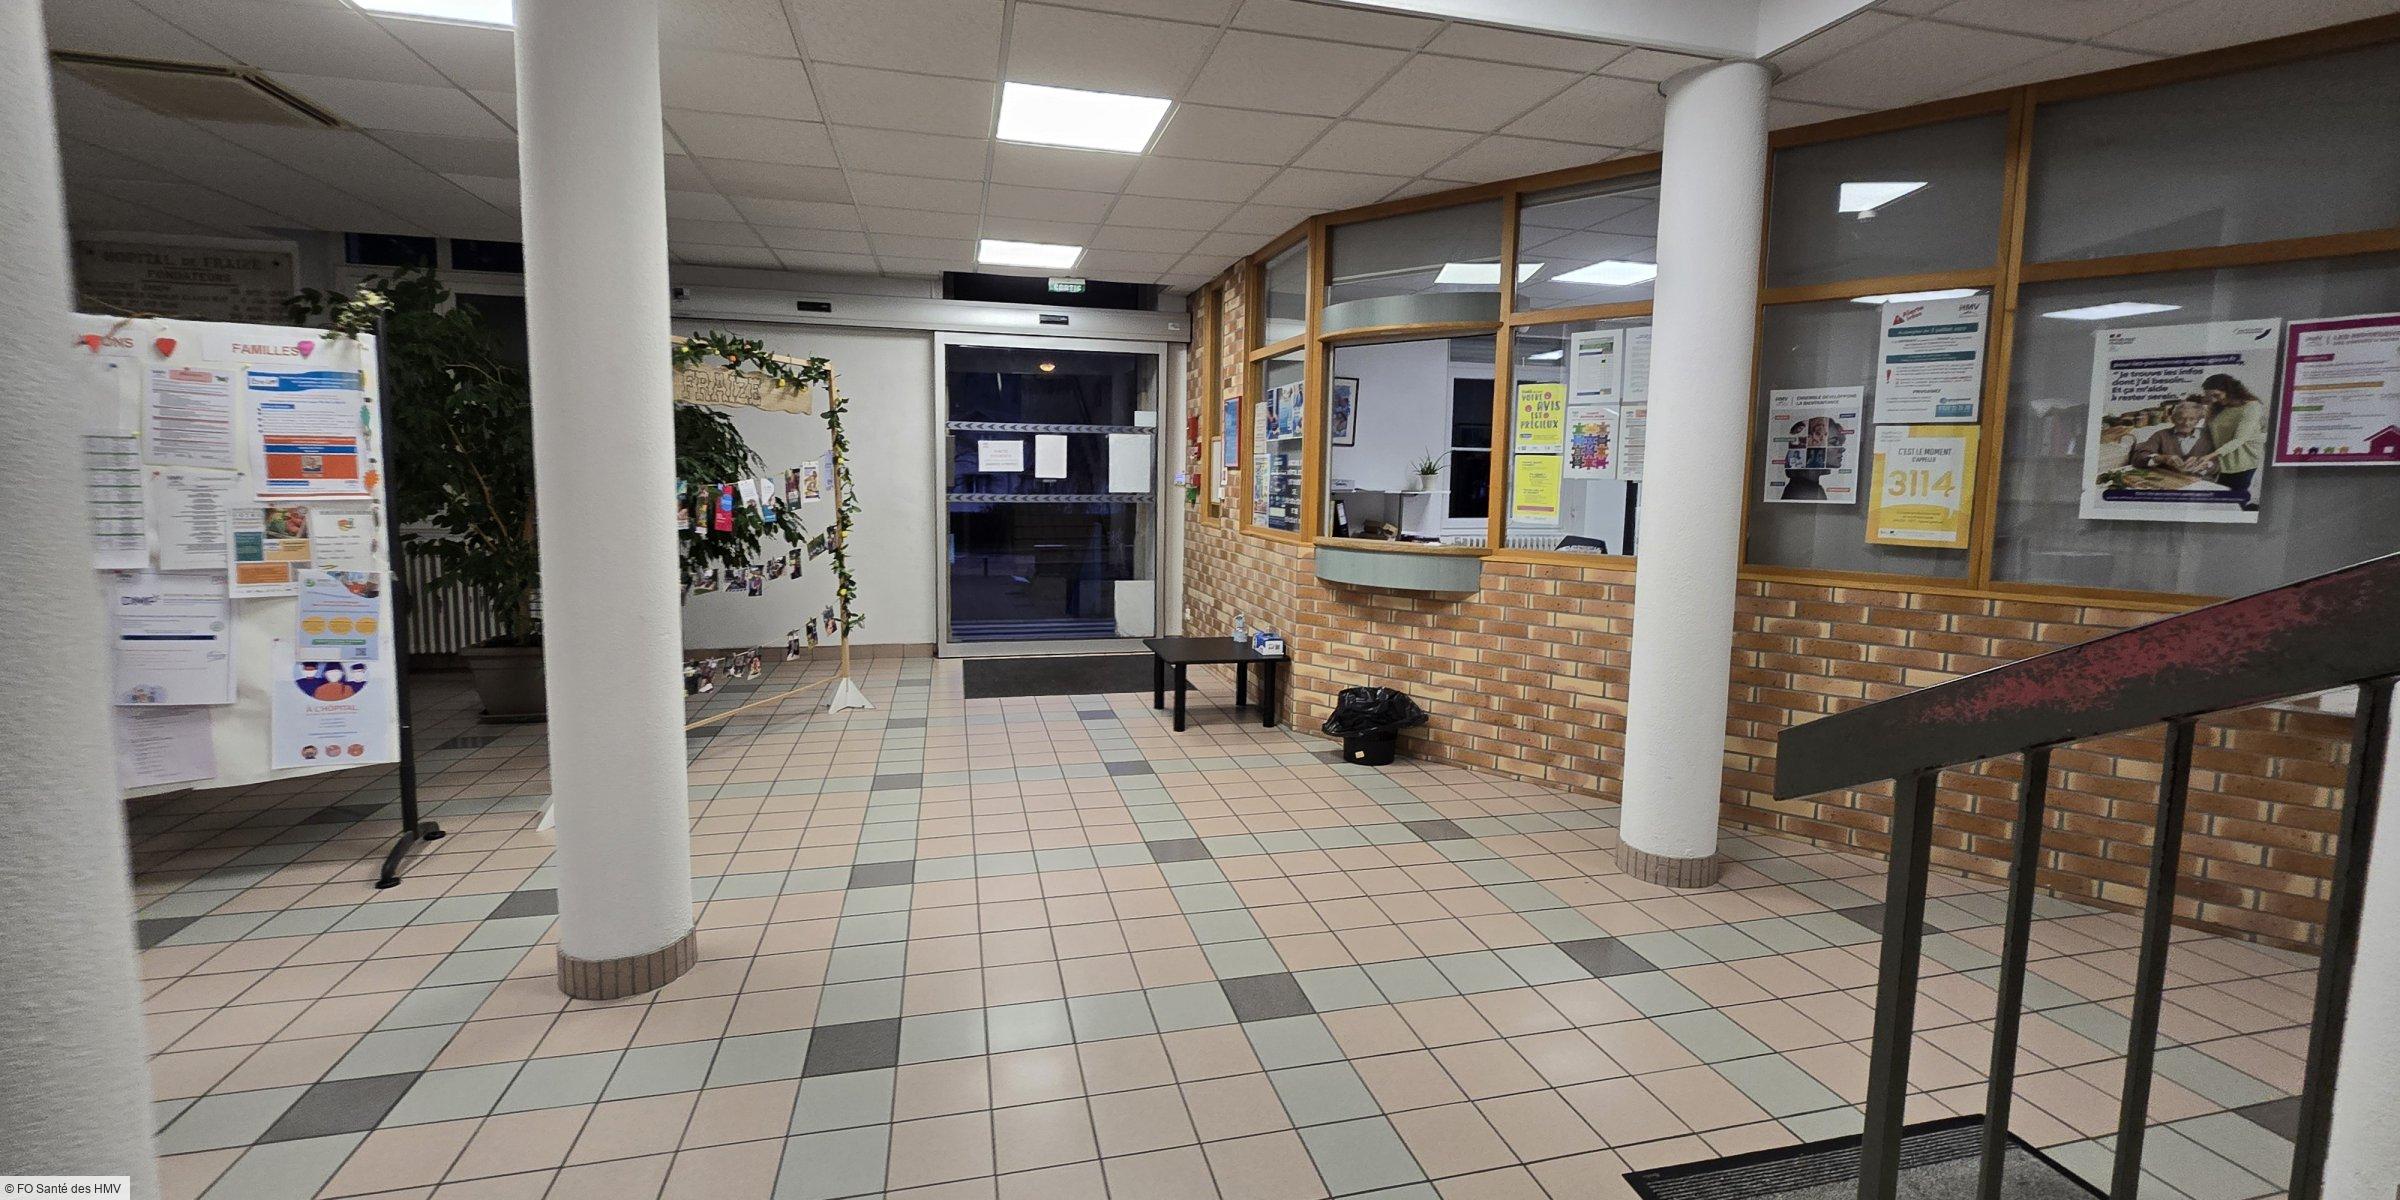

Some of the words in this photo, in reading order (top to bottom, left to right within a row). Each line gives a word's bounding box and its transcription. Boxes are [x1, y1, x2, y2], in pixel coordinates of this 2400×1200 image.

[101, 335, 134, 348] ONS
[232, 343, 299, 356] FAMILLES
[683, 369, 761, 406] FRAIZE
[2112, 378, 2135, 386] dont
[1536, 400, 1560, 411] AVIS
[1915, 448, 1923, 456] LE
[1924, 447, 1952, 456] MOMENT
[1888, 469, 1955, 497] 3114
